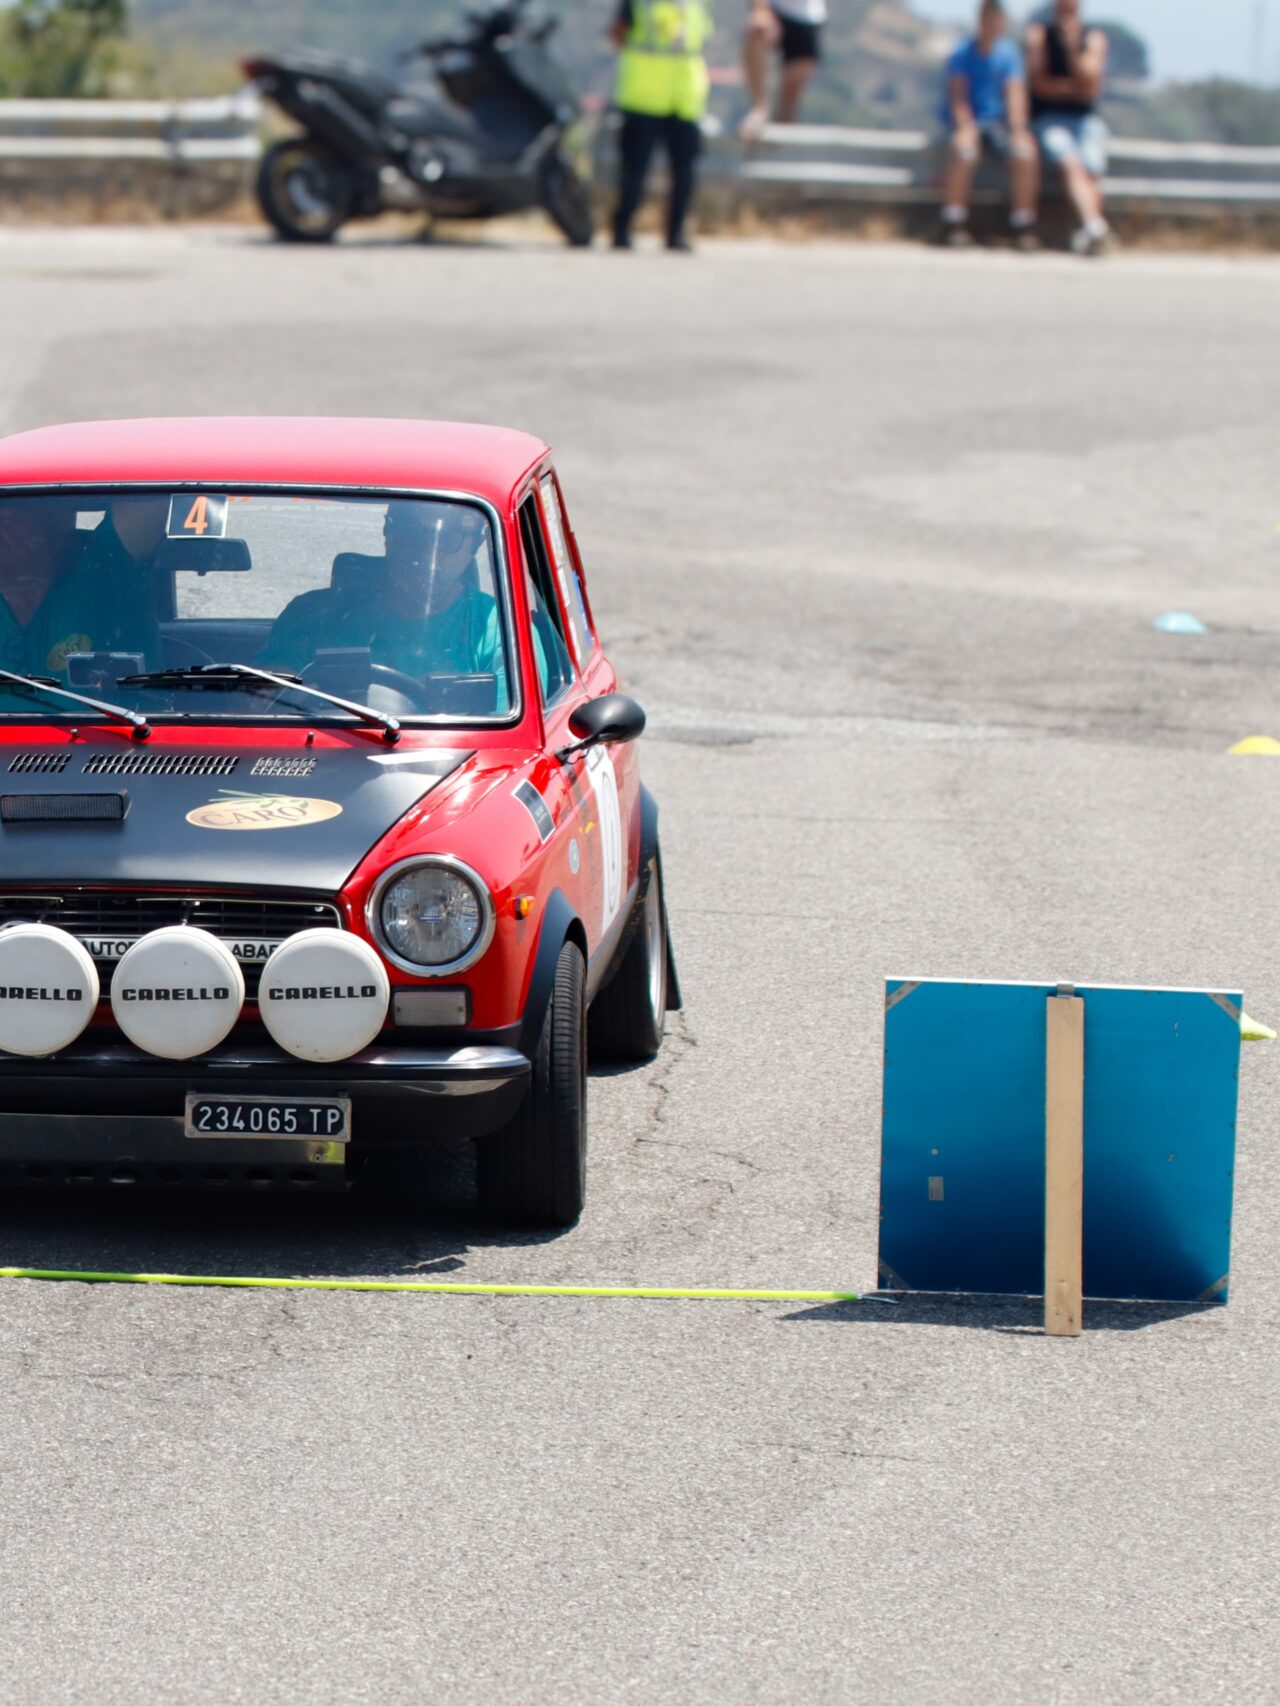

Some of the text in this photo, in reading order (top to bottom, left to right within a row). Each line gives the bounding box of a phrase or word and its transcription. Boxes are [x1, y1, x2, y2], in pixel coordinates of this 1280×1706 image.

[183, 495, 209, 535] 4
[200, 805, 308, 827] CARO
[121, 986, 230, 1001] CARELLO
[269, 985, 377, 1001] CARELLO
[198, 1105, 341, 1134] 234065 TP
